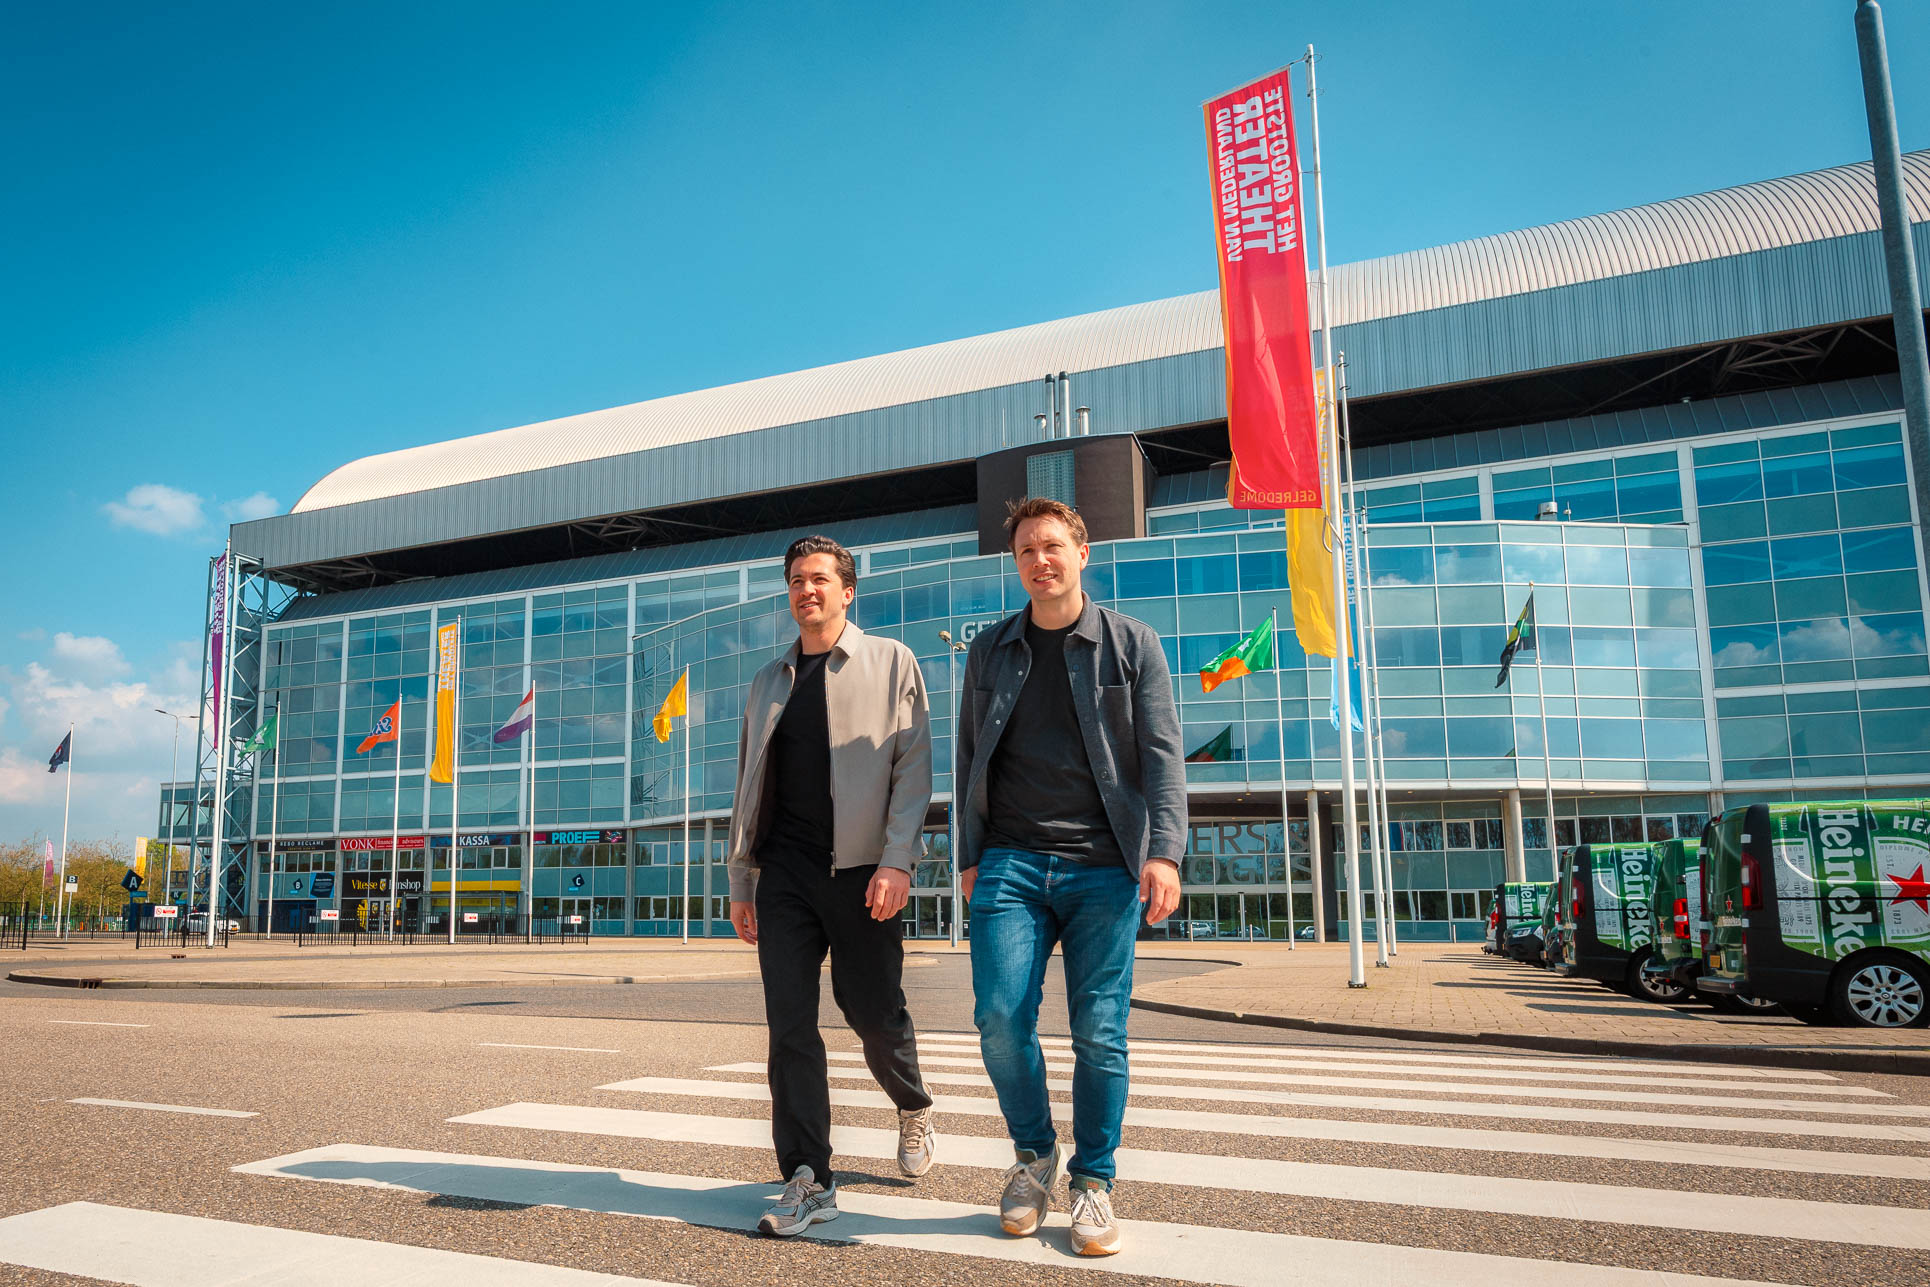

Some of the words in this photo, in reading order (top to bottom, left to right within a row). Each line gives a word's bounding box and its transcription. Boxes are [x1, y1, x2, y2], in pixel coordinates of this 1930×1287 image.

[1893, 816, 1930, 834] HE
[342, 839, 375, 850] VONK
[460, 835, 490, 846] KASSA
[129, 877, 138, 888] A
[351, 879, 378, 890] Vitesse
[575, 877, 581, 886] C
[1818, 808, 1873, 962] Heineke
[1621, 848, 1652, 953] Heineke
